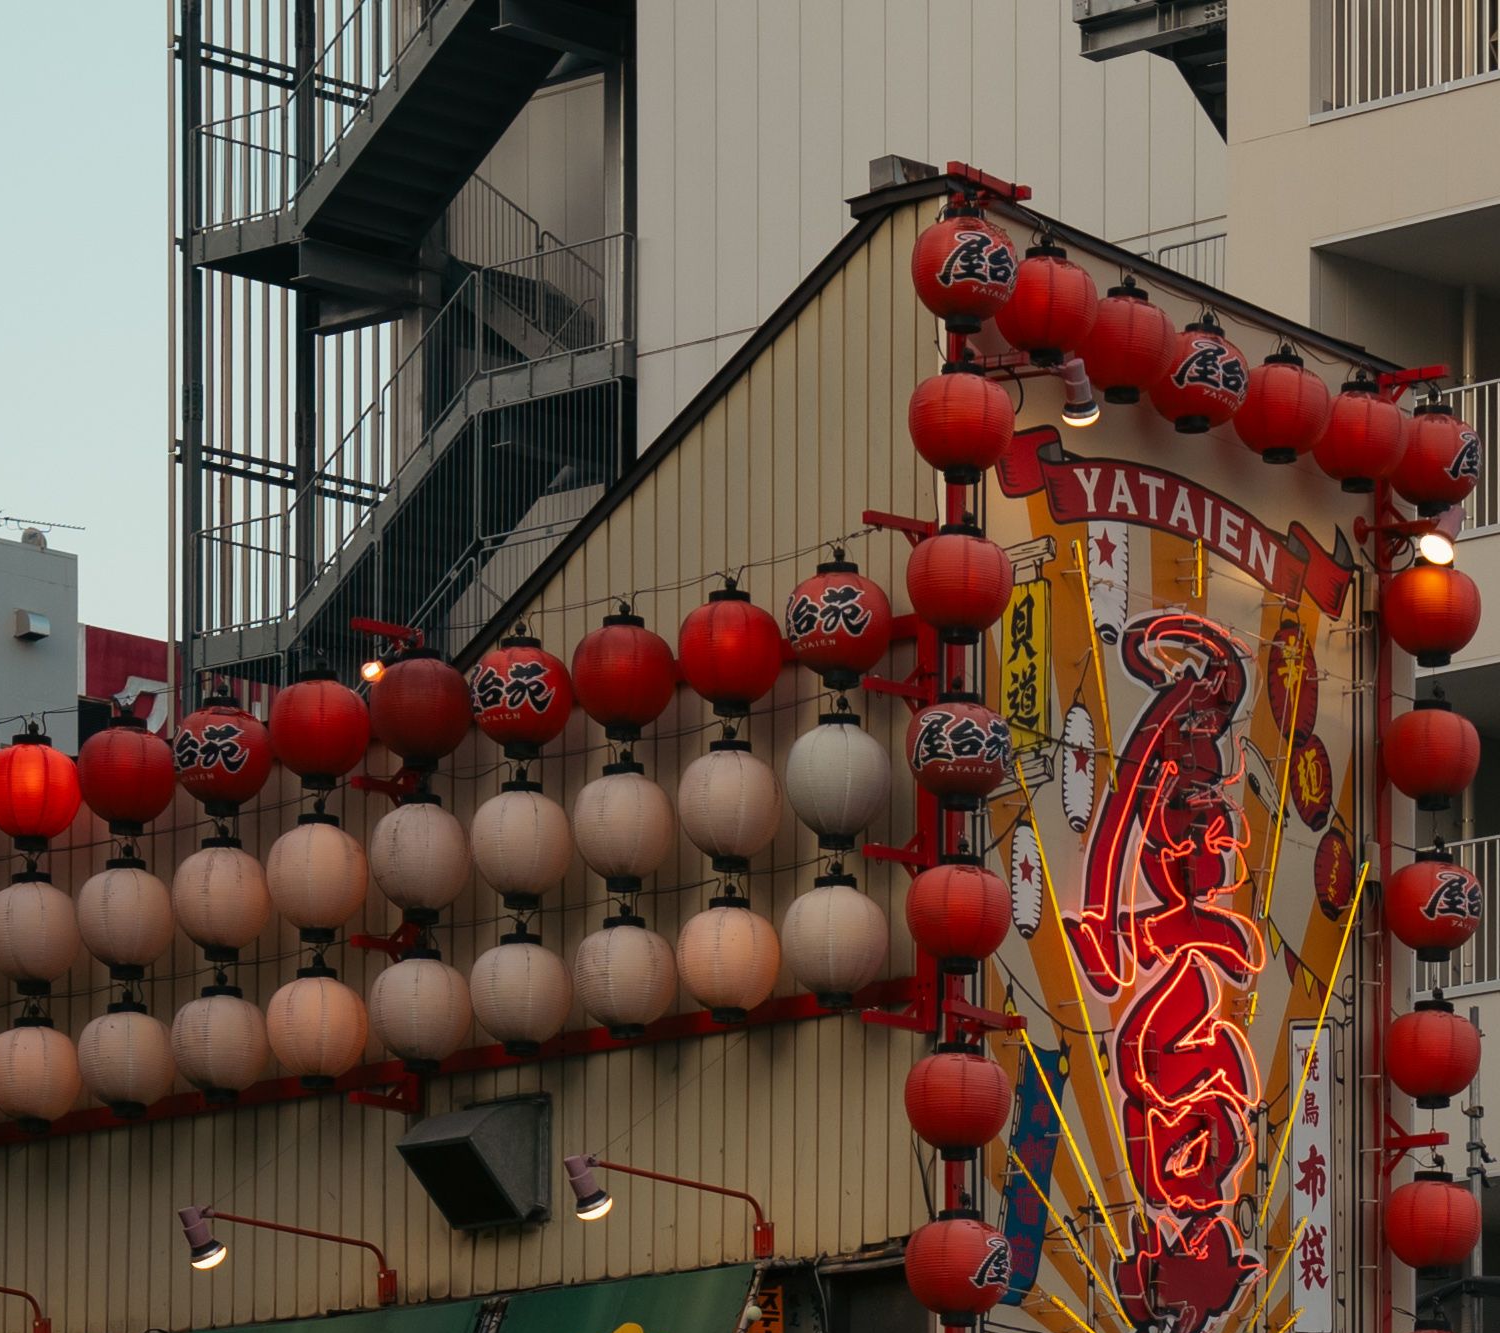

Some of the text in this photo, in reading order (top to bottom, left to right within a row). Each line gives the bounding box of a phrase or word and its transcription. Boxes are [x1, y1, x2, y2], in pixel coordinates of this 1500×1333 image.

[937, 231, 1018, 290] 屋台
[1170, 338, 1249, 395] 屋台
[1073, 467, 1278, 585] YATAIEN
[785, 584, 872, 642] 台苑
[470, 660, 556, 714] 台苑
[172, 722, 250, 774] 台苑
[938, 763, 994, 776] YATAIEN
